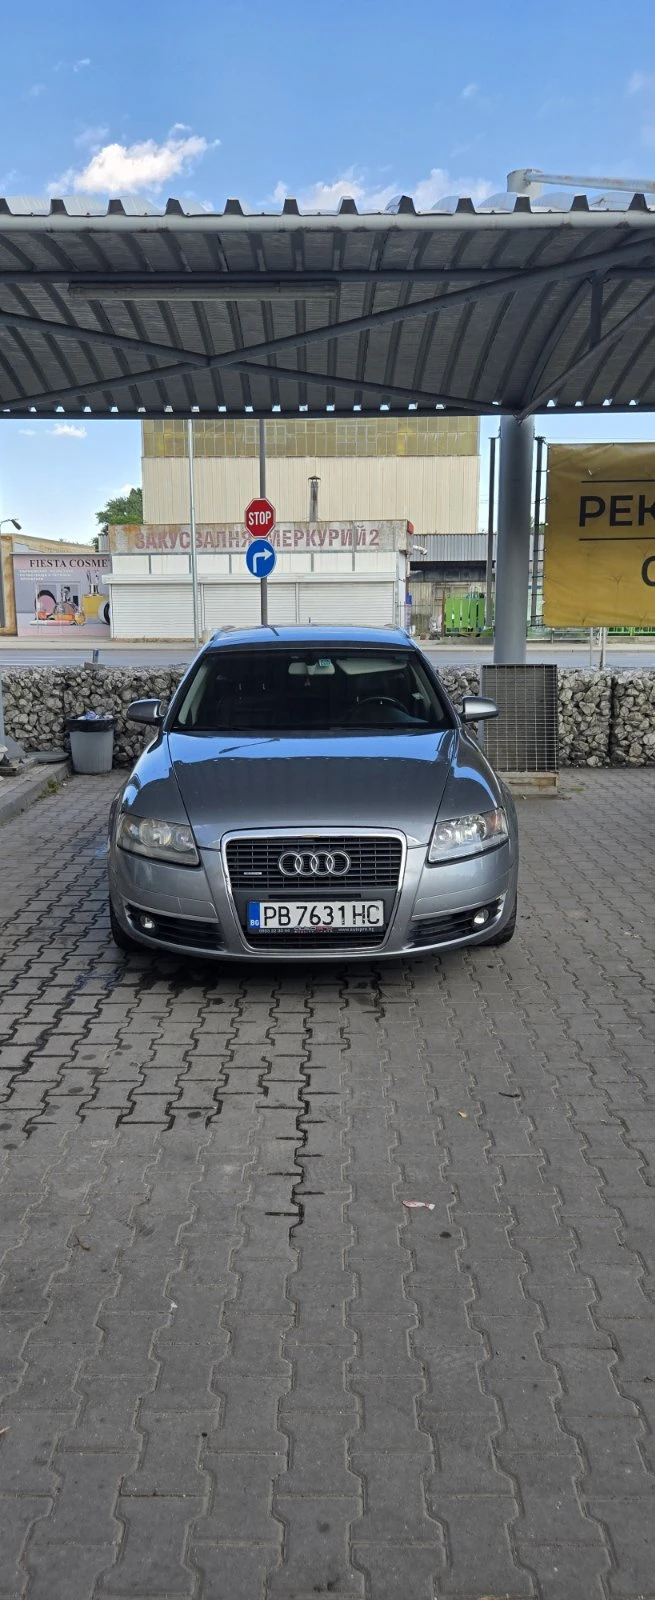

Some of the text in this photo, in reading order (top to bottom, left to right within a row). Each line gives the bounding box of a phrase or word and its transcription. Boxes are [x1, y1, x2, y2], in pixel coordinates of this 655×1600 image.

[248, 511, 272, 526] STOP
[30, 559, 109, 568] FIESTA COSME
